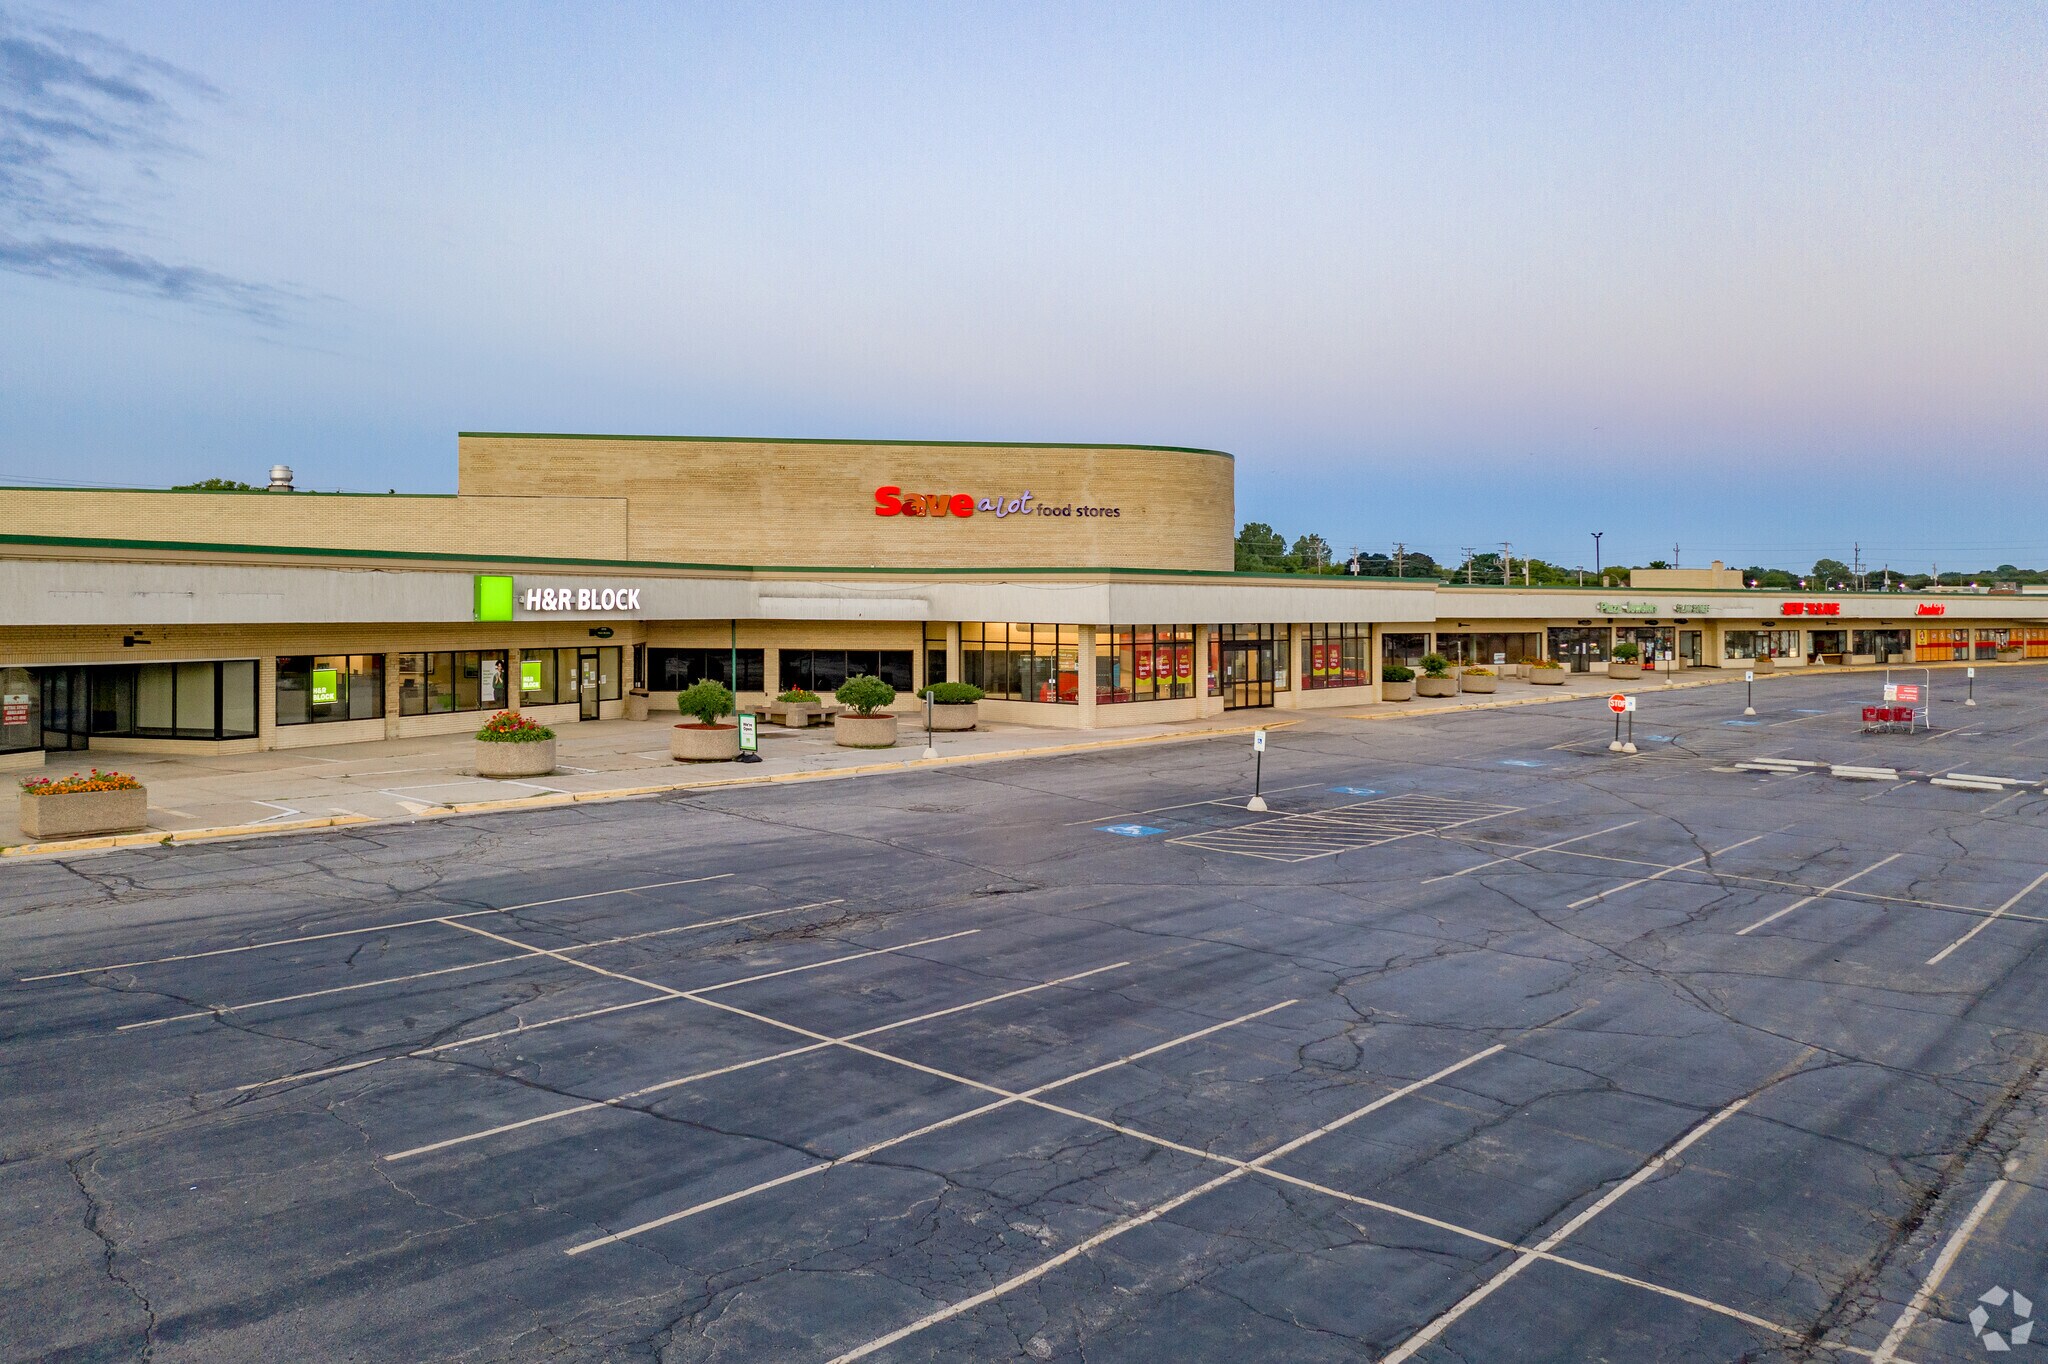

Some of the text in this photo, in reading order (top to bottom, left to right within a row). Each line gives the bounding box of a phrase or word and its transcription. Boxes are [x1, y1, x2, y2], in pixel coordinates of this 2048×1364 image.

[875, 486, 974, 517] Save
[1036, 504, 1072, 517] food
[1076, 506, 1120, 517] stores
[526, 588, 640, 611] H&R BLOCK
